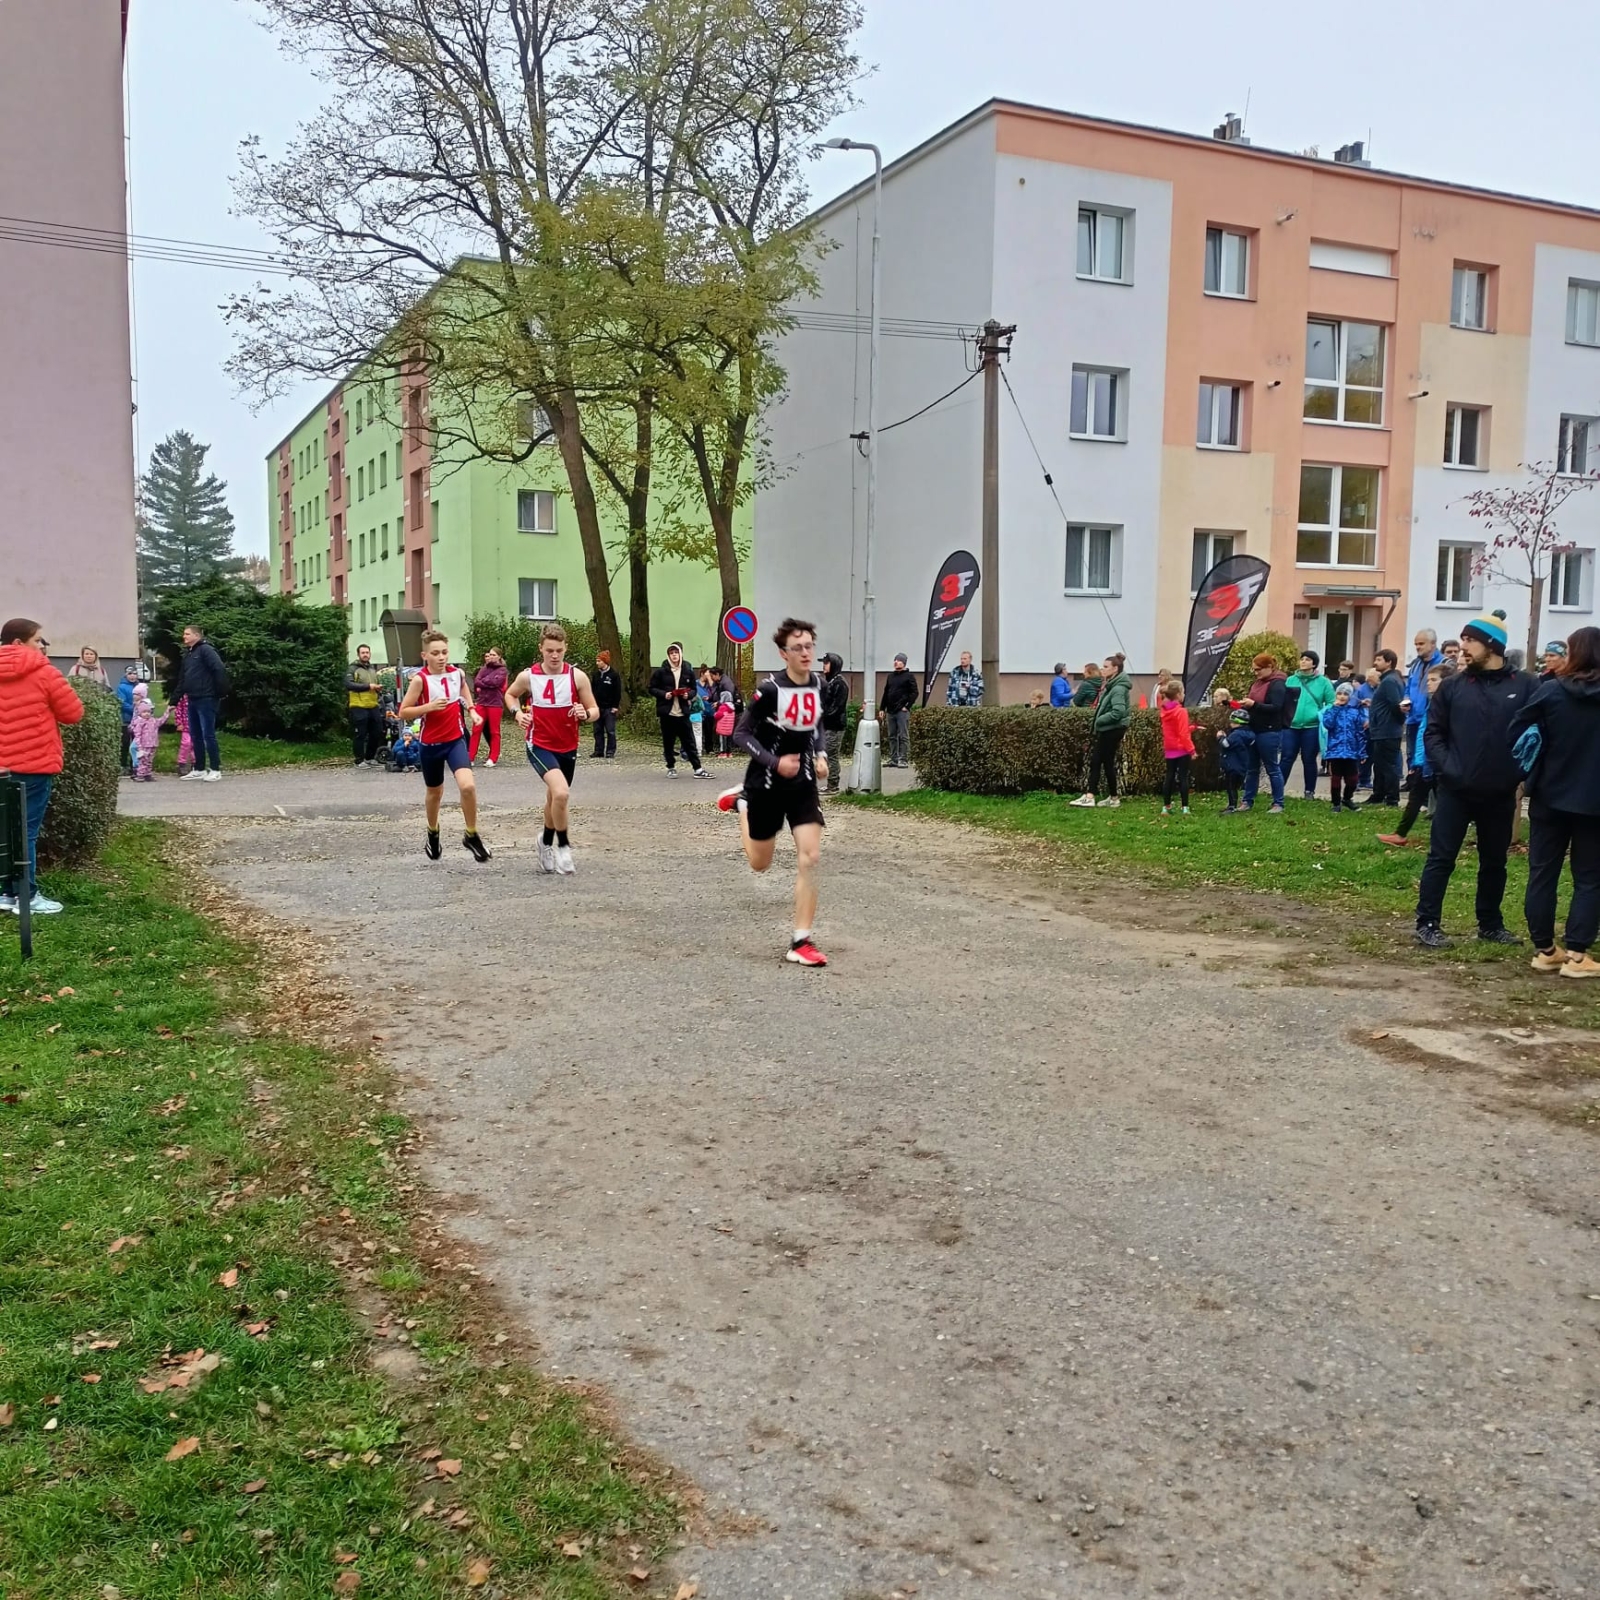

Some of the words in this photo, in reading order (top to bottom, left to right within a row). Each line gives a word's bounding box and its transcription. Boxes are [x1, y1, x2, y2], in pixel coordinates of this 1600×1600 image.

[940, 570, 974, 602] 3F
[1206, 572, 1263, 619] 3F
[440, 677, 450, 698] 1
[543, 679, 556, 705] 4
[784, 692, 816, 726] 49
